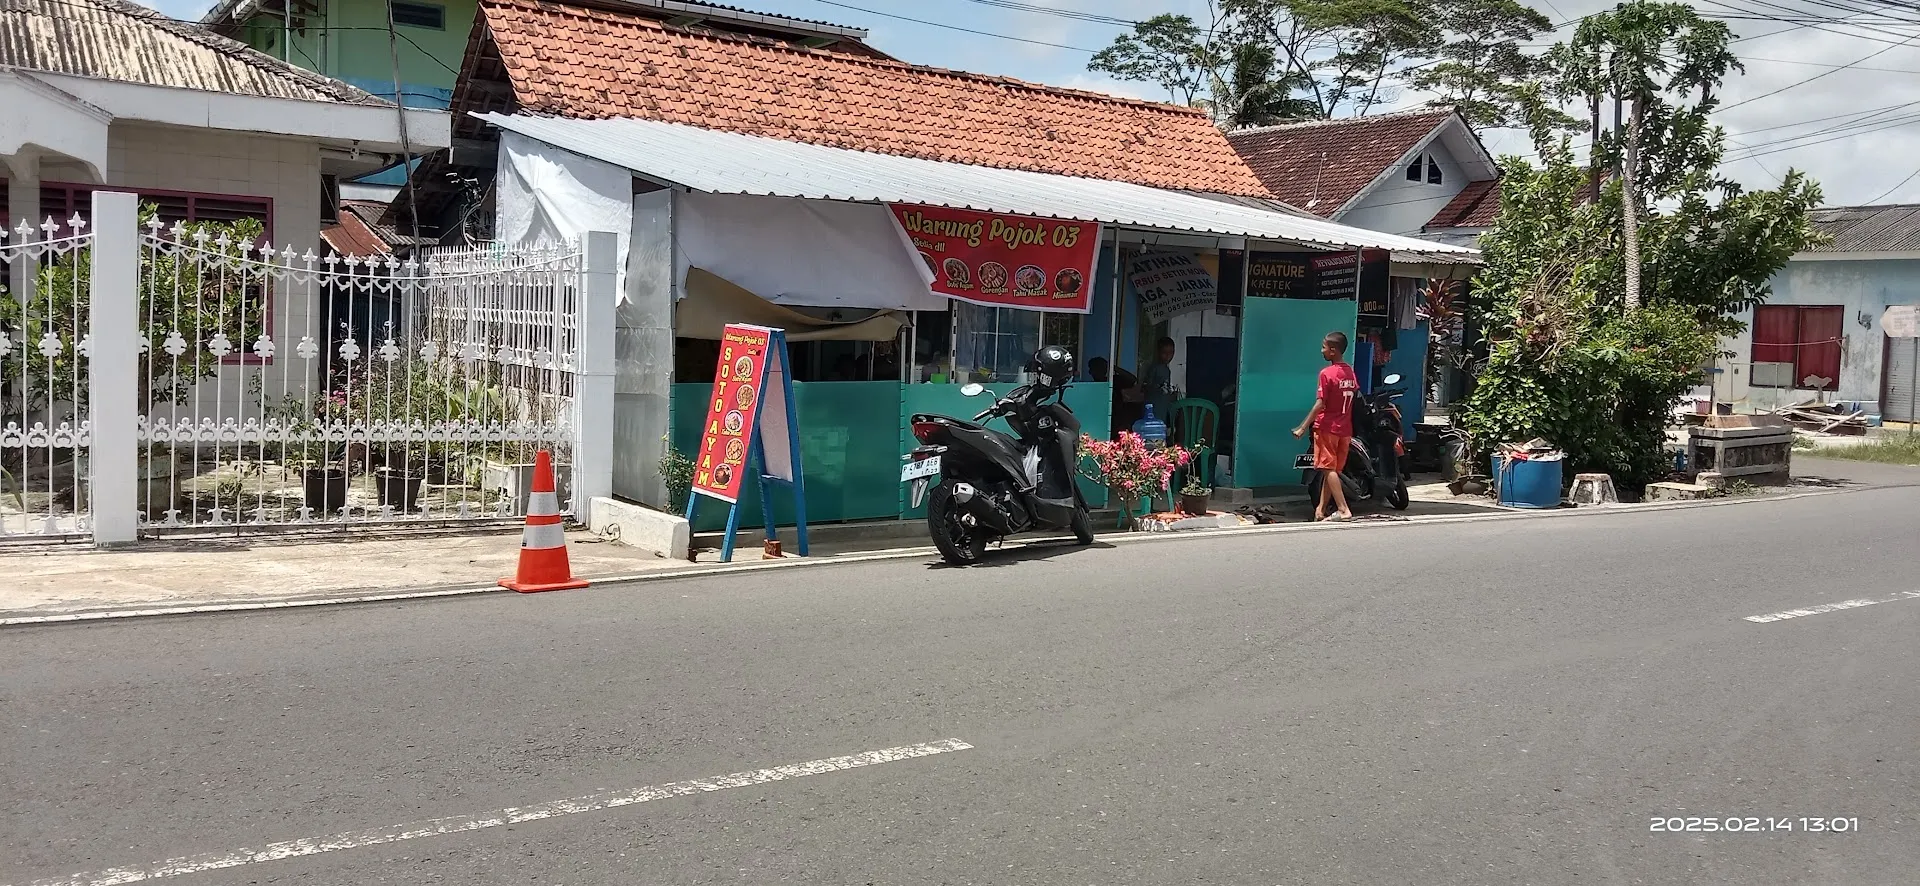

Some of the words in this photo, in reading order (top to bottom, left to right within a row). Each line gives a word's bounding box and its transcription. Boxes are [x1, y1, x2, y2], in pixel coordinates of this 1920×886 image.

[902, 210, 984, 248] Warung
[988, 218, 1048, 250] Pojok
[1052, 224, 1081, 248] 03
[935, 241, 945, 252] dll
[1162, 269, 1186, 280] SETIR
[980, 286, 1009, 296] Gorengan
[1177, 278, 1214, 292] JARAK
[1251, 279, 1292, 291] KRETEK
[1012, 289, 1028, 298] Tahu
[1028, 288, 1048, 297] Masak
[714, 346, 733, 413] SOTO
[697, 420, 719, 487] AYAM
